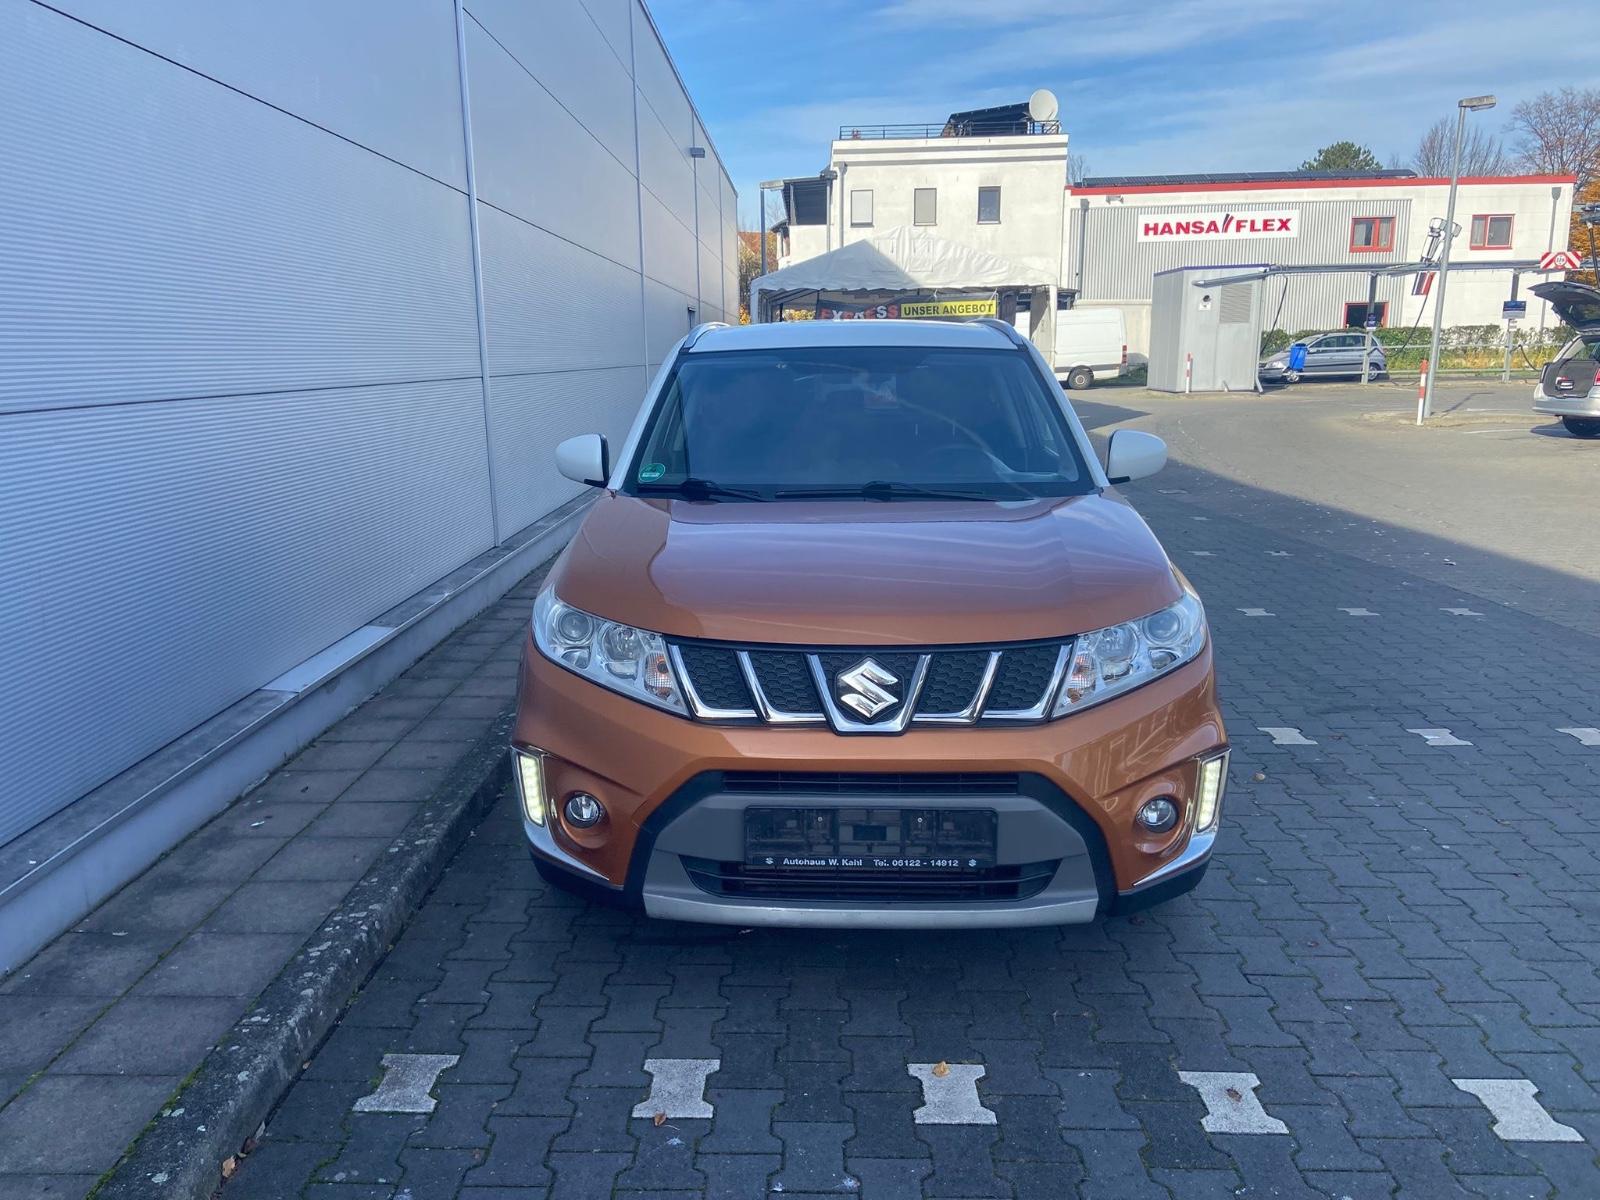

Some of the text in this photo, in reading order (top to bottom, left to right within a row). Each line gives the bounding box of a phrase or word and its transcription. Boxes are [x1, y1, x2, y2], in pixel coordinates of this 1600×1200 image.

[1143, 218, 1292, 236] HANSA FLEX
[903, 302, 994, 316] UNSER ANGEBOT
[783, 857, 826, 866] Autohaus
[828, 858, 839, 866] W.
